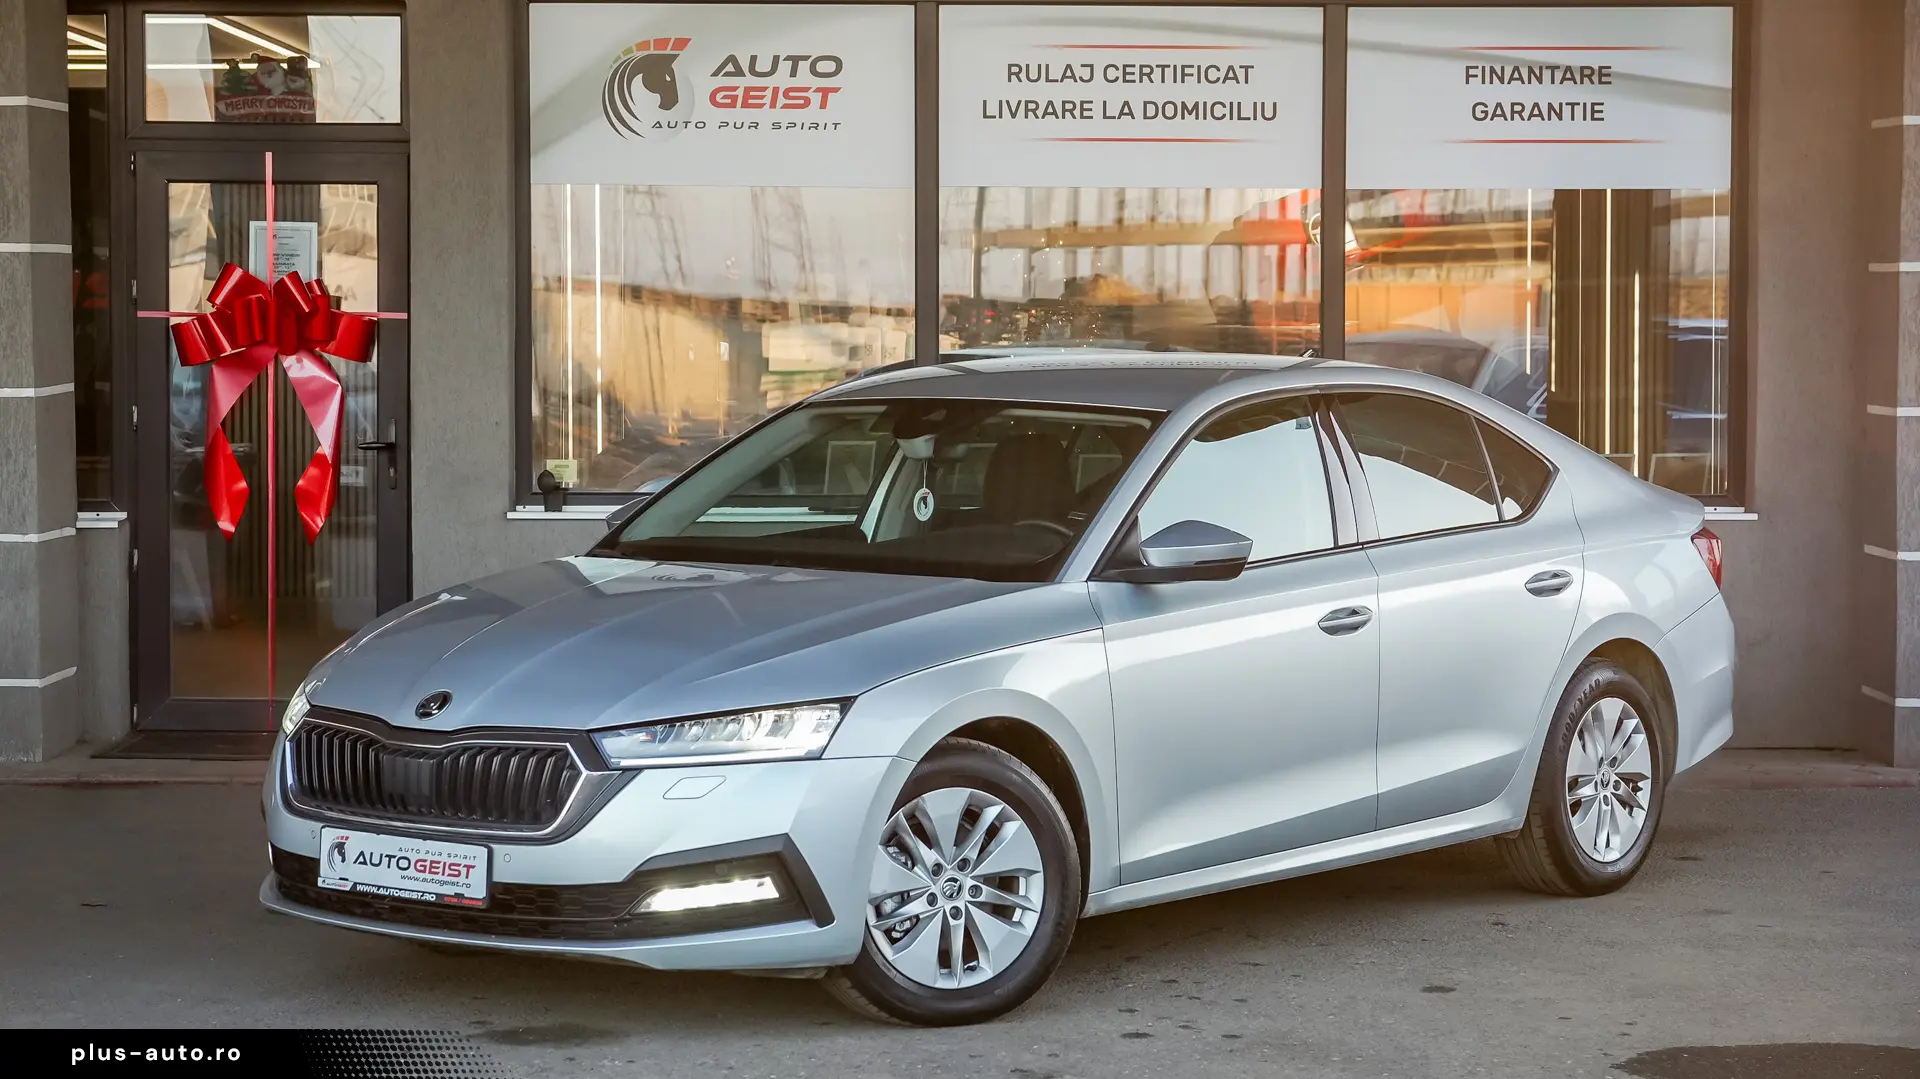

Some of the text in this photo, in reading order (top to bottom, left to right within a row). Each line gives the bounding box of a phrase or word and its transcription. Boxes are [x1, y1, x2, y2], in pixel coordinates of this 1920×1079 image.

[710, 54, 843, 78] AUTO
[1007, 64, 1254, 84] RULAJ CERTIFICAT
[1466, 65, 1611, 85] FINANTARE
[224, 98, 264, 112] MERRY
[709, 85, 842, 109] GEIST
[983, 100, 1277, 121] LIVRARE LA DOMICILIU
[1472, 102, 1604, 122] GARANTIE
[651, 121, 842, 131] AUTO PUR SPIRIT
[398, 847, 421, 855] AUTO
[447, 853, 477, 862] SPIRIT
[400, 874, 472, 889] www.autogeist.ro
[356, 884, 437, 901] WWW.AUTOGEIST.RO
